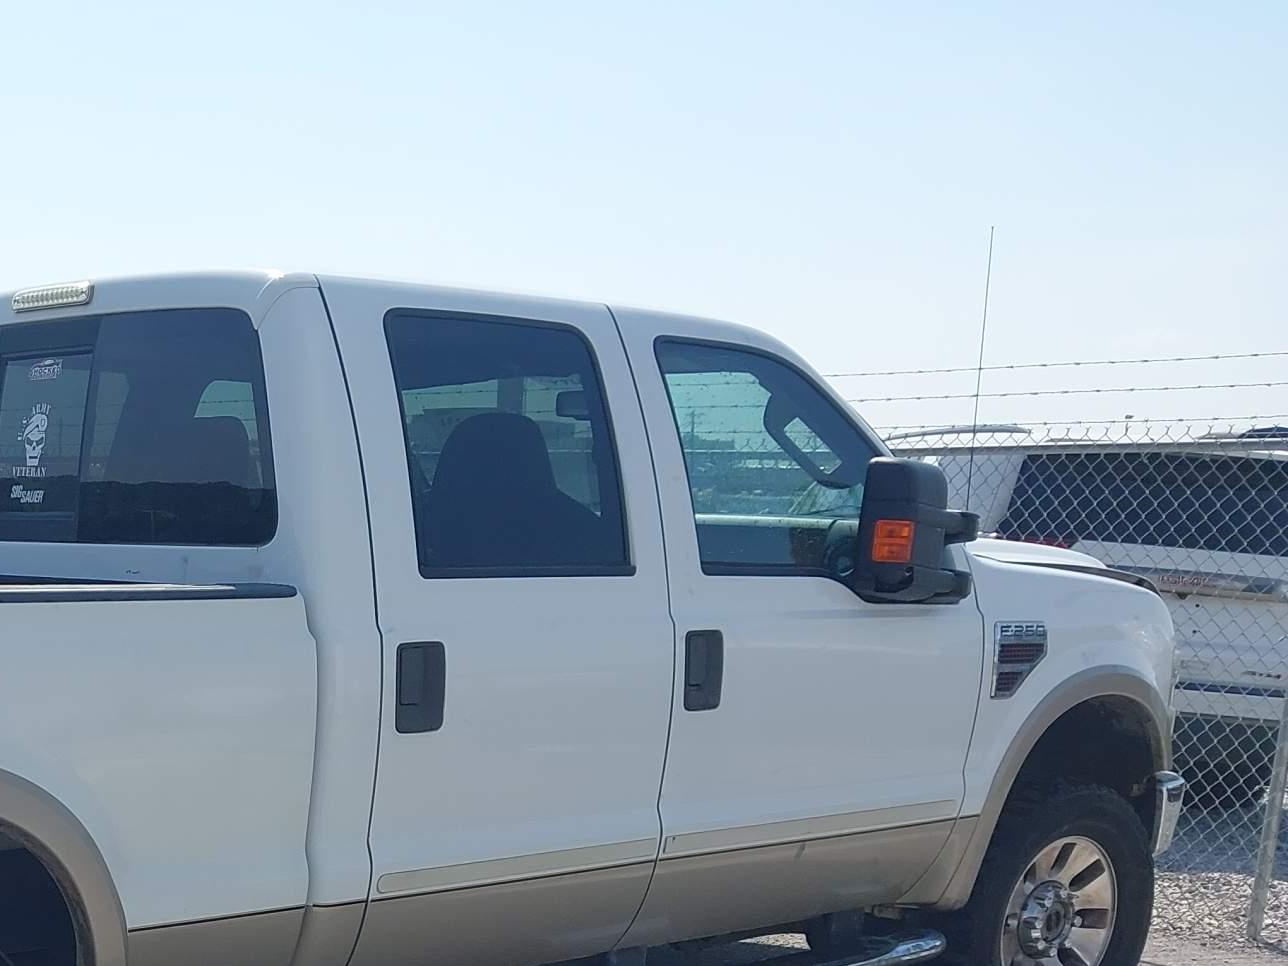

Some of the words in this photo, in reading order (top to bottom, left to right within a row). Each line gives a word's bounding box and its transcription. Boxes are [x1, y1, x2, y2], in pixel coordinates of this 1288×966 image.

[13, 466, 47, 477] VETERAN
[11, 485, 24, 498] SIG
[20, 491, 45, 504] SAUER
